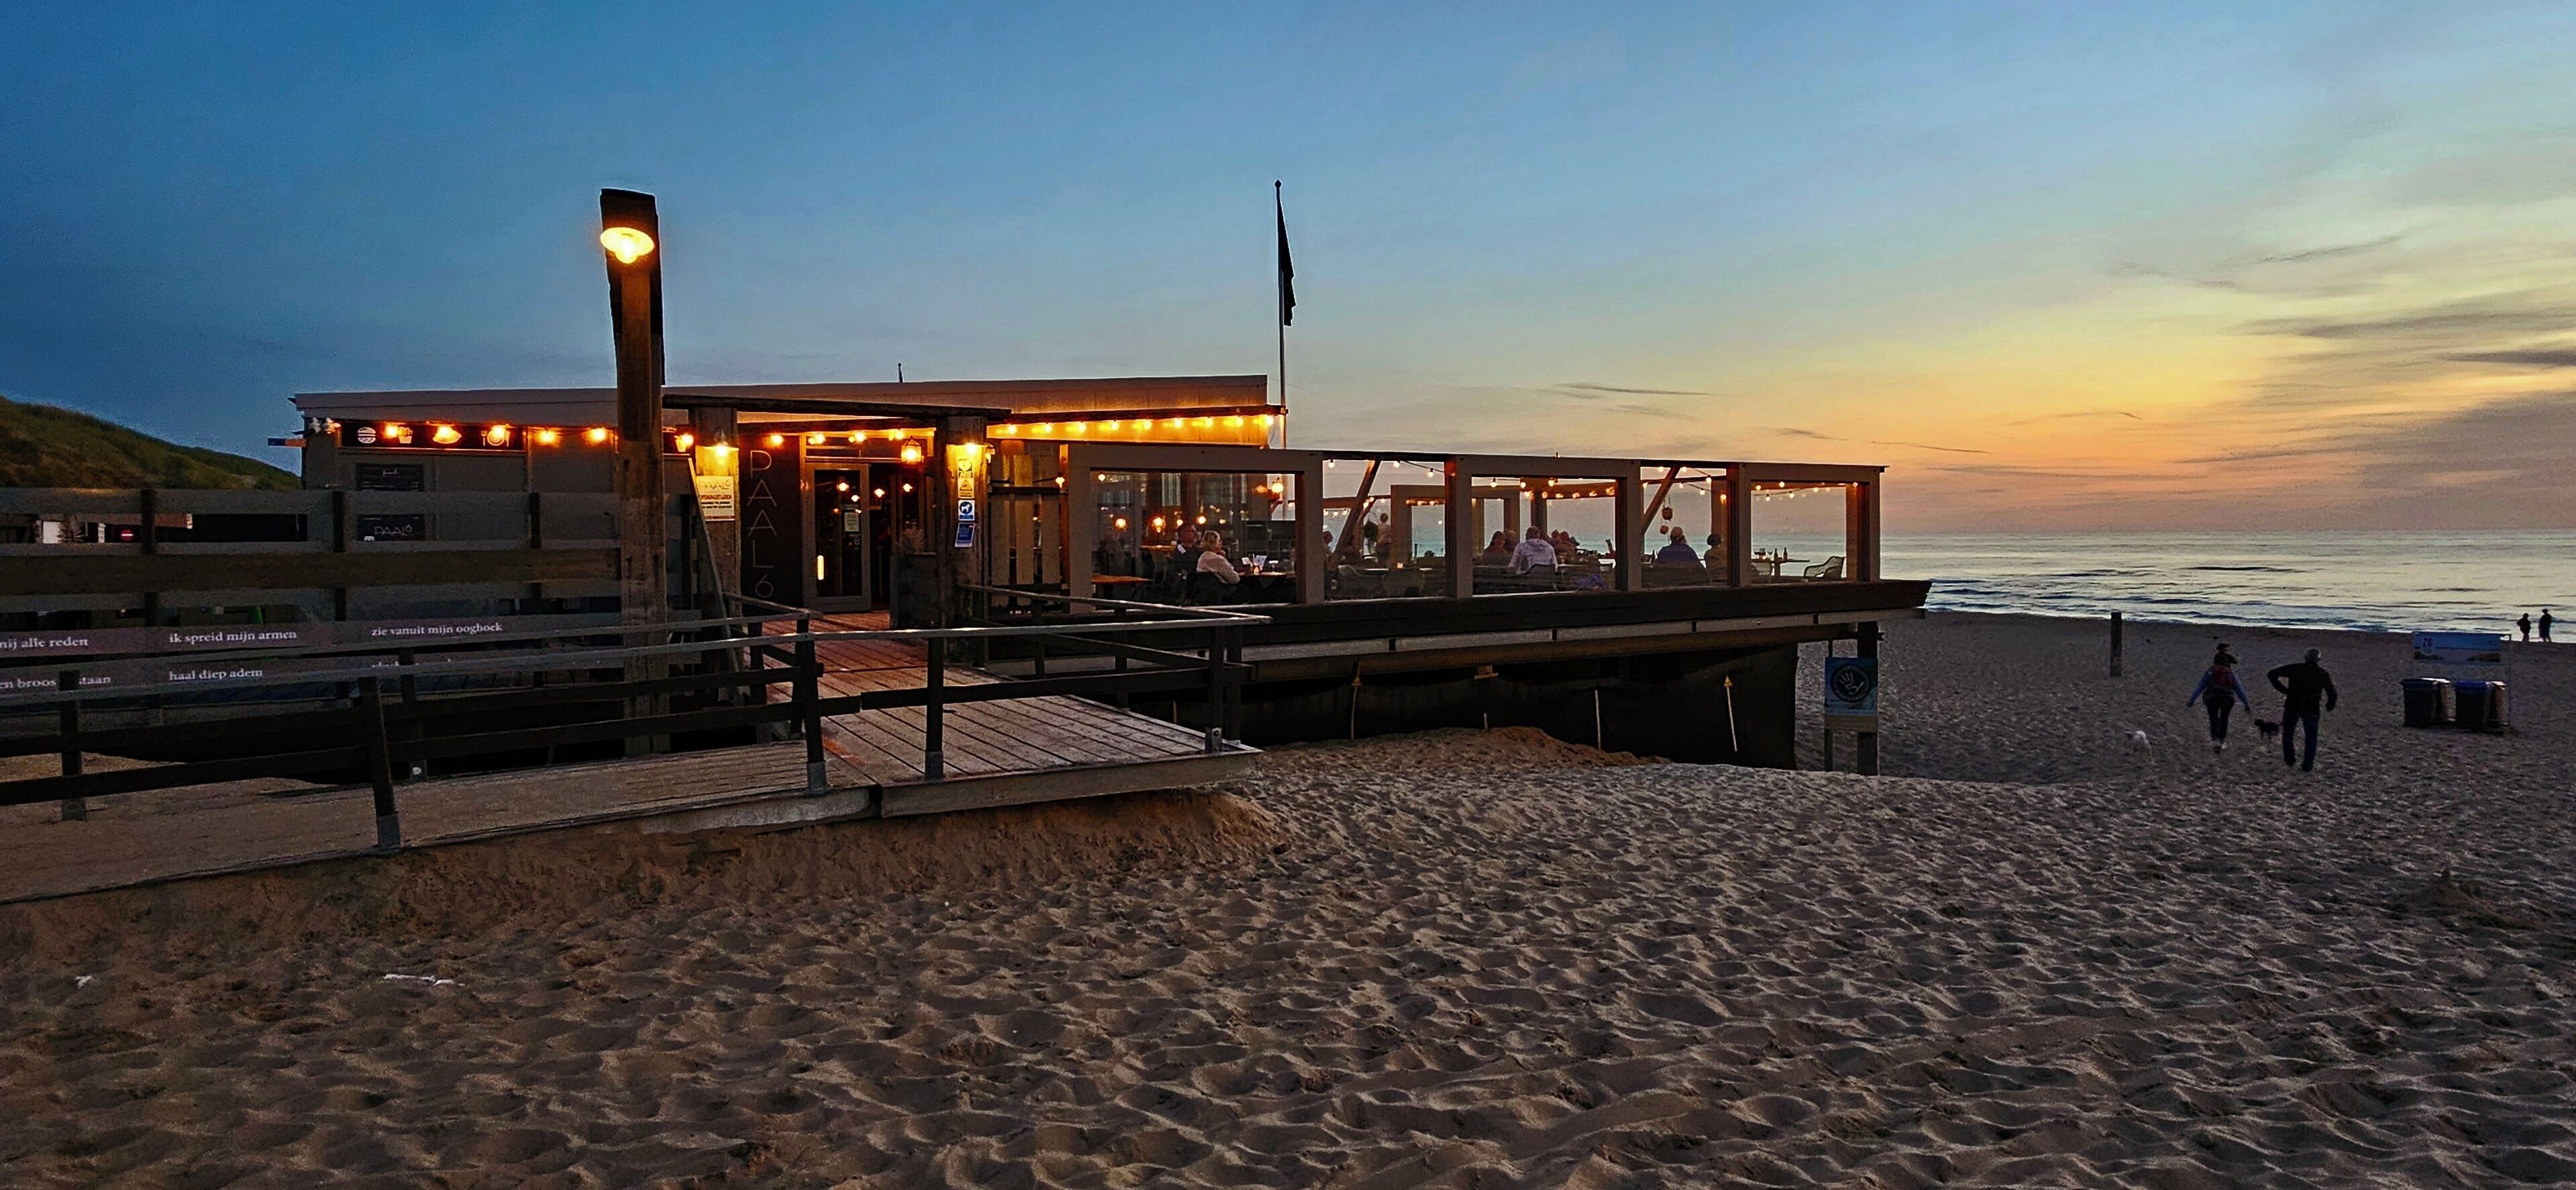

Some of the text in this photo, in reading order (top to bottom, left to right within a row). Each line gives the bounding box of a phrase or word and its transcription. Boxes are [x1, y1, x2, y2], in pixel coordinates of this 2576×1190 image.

[372, 623, 502, 636] zie vanuit mijn ooghoek
[49, 637, 88, 647] reden
[169, 631, 297, 645] ik spreid mijn armen
[169, 668, 263, 681] haal diep adem
[17, 678, 57, 688] broos
